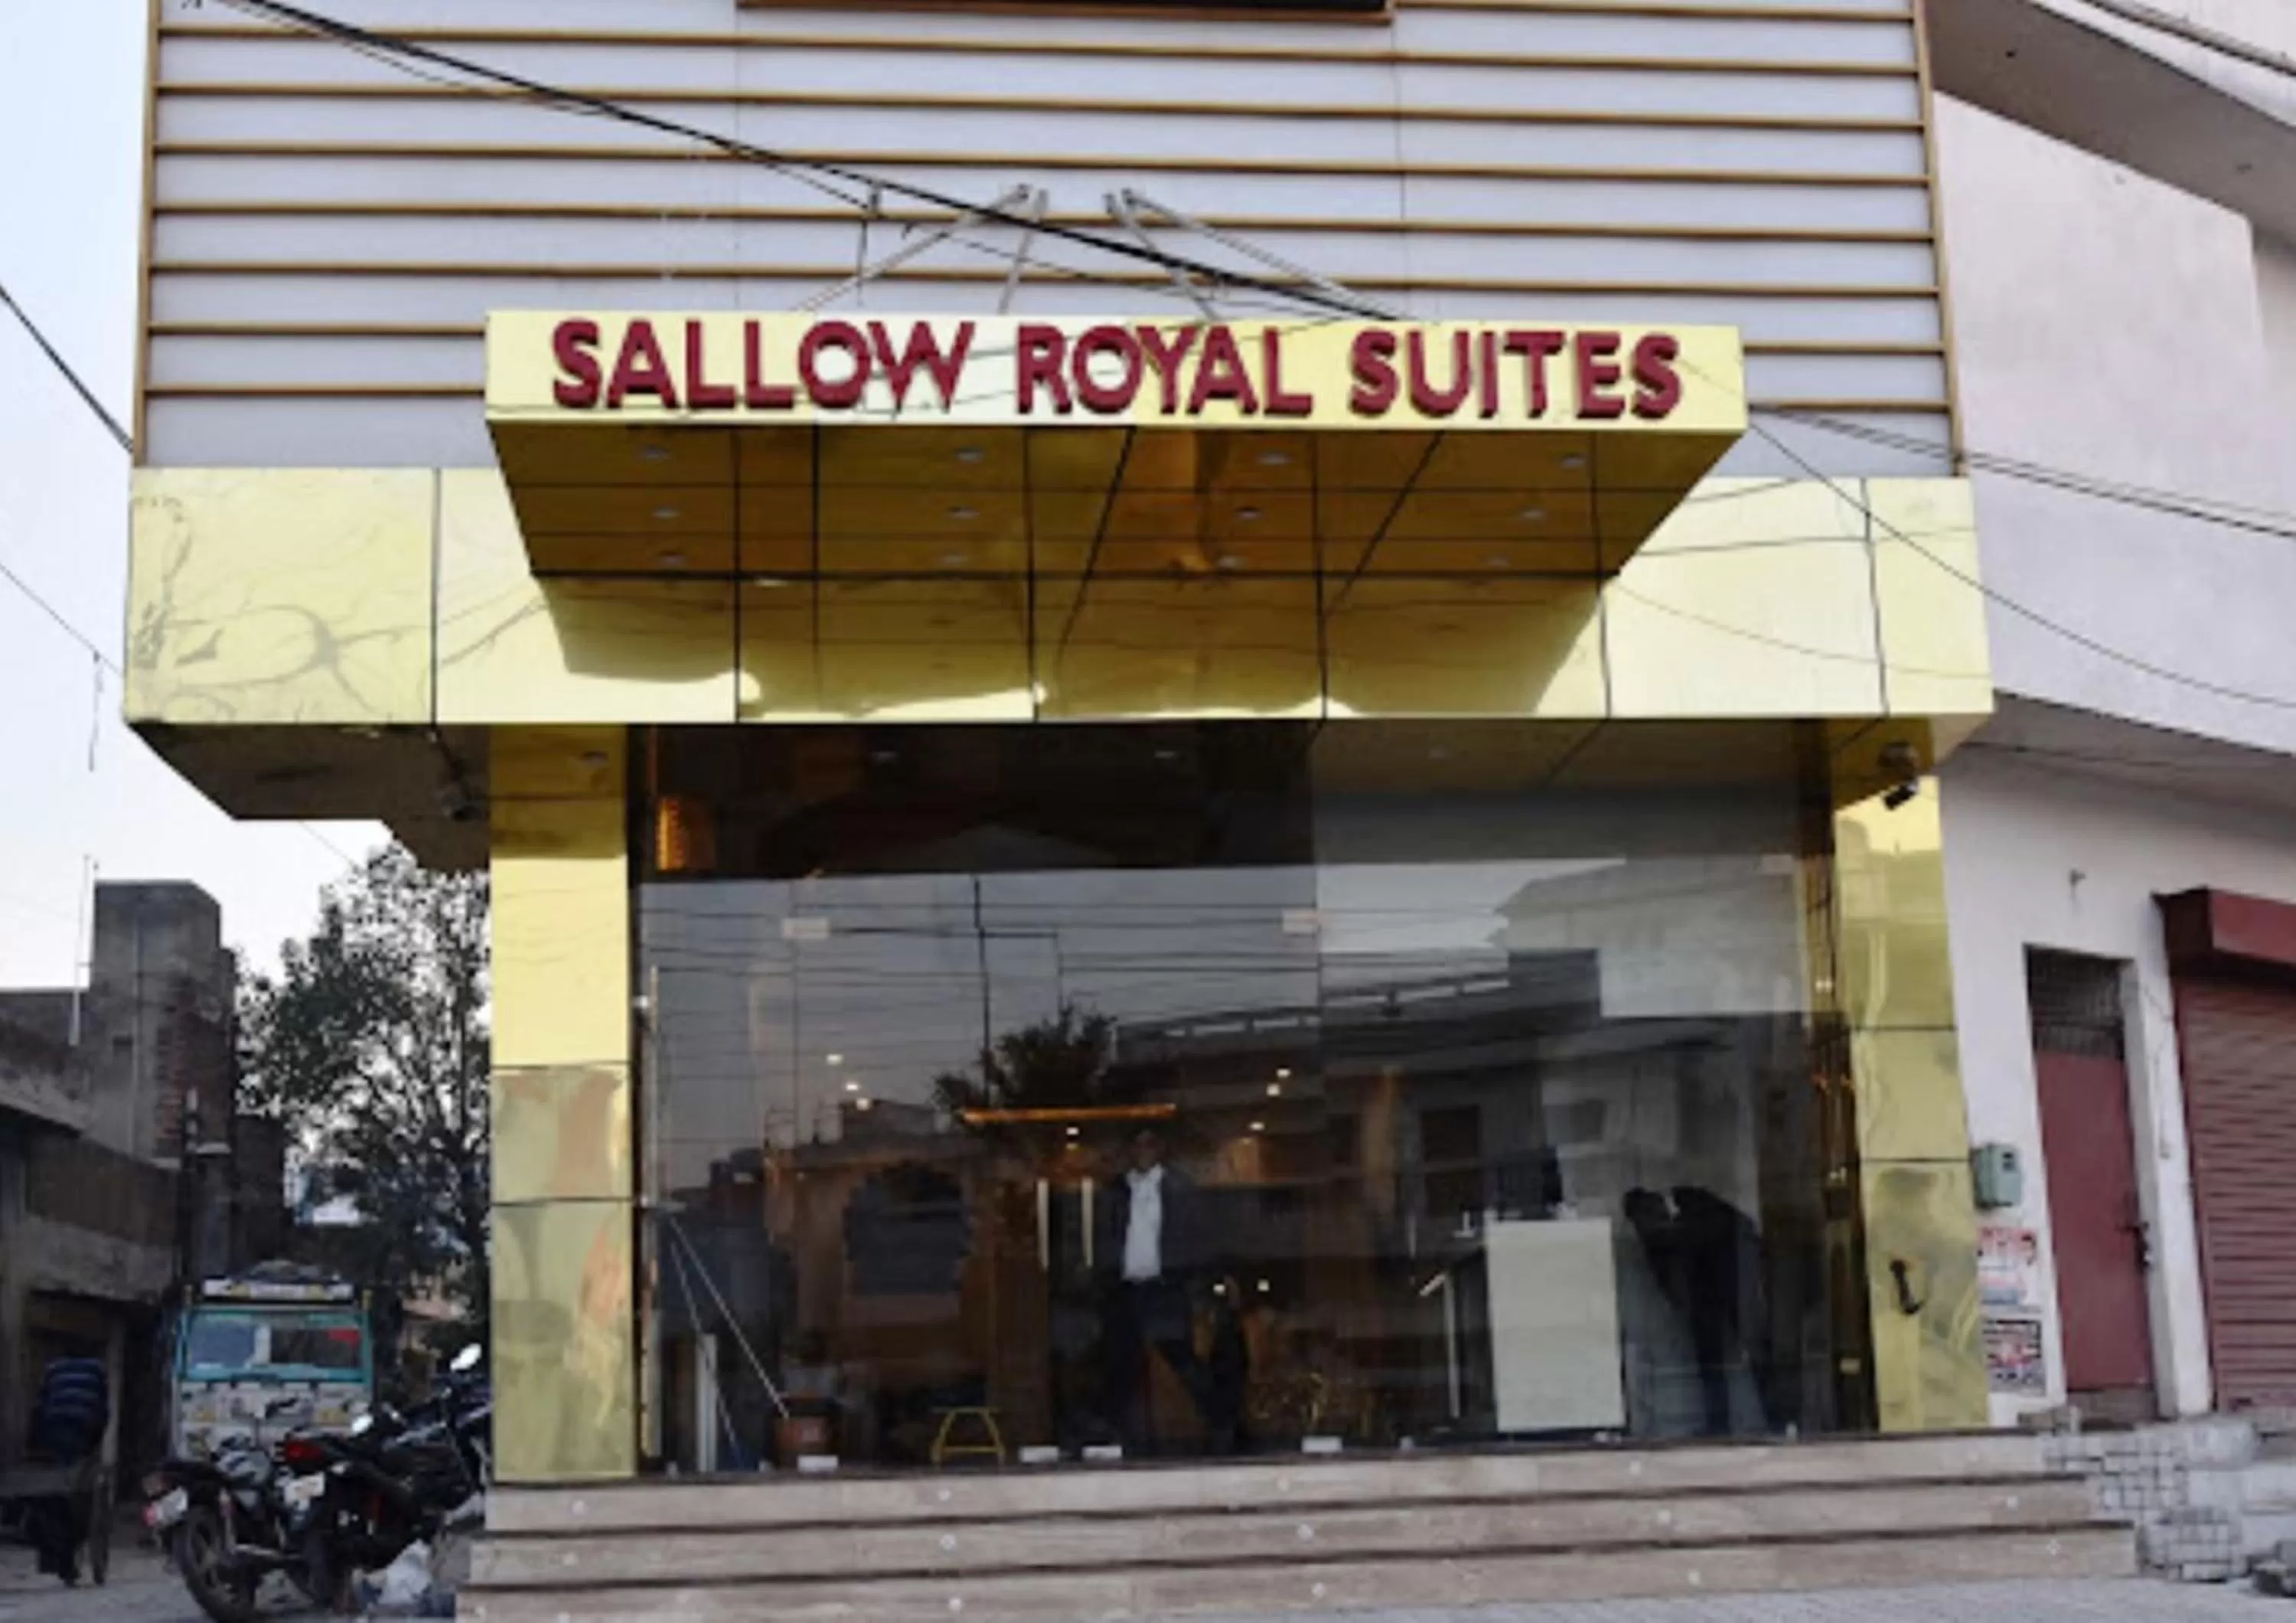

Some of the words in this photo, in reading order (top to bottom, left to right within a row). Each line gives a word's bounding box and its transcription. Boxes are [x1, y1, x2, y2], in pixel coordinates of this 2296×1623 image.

[551, 318, 975, 411] SALLOW
[1016, 324, 1313, 417] ROYAL
[1351, 328, 1681, 419] SUITES
